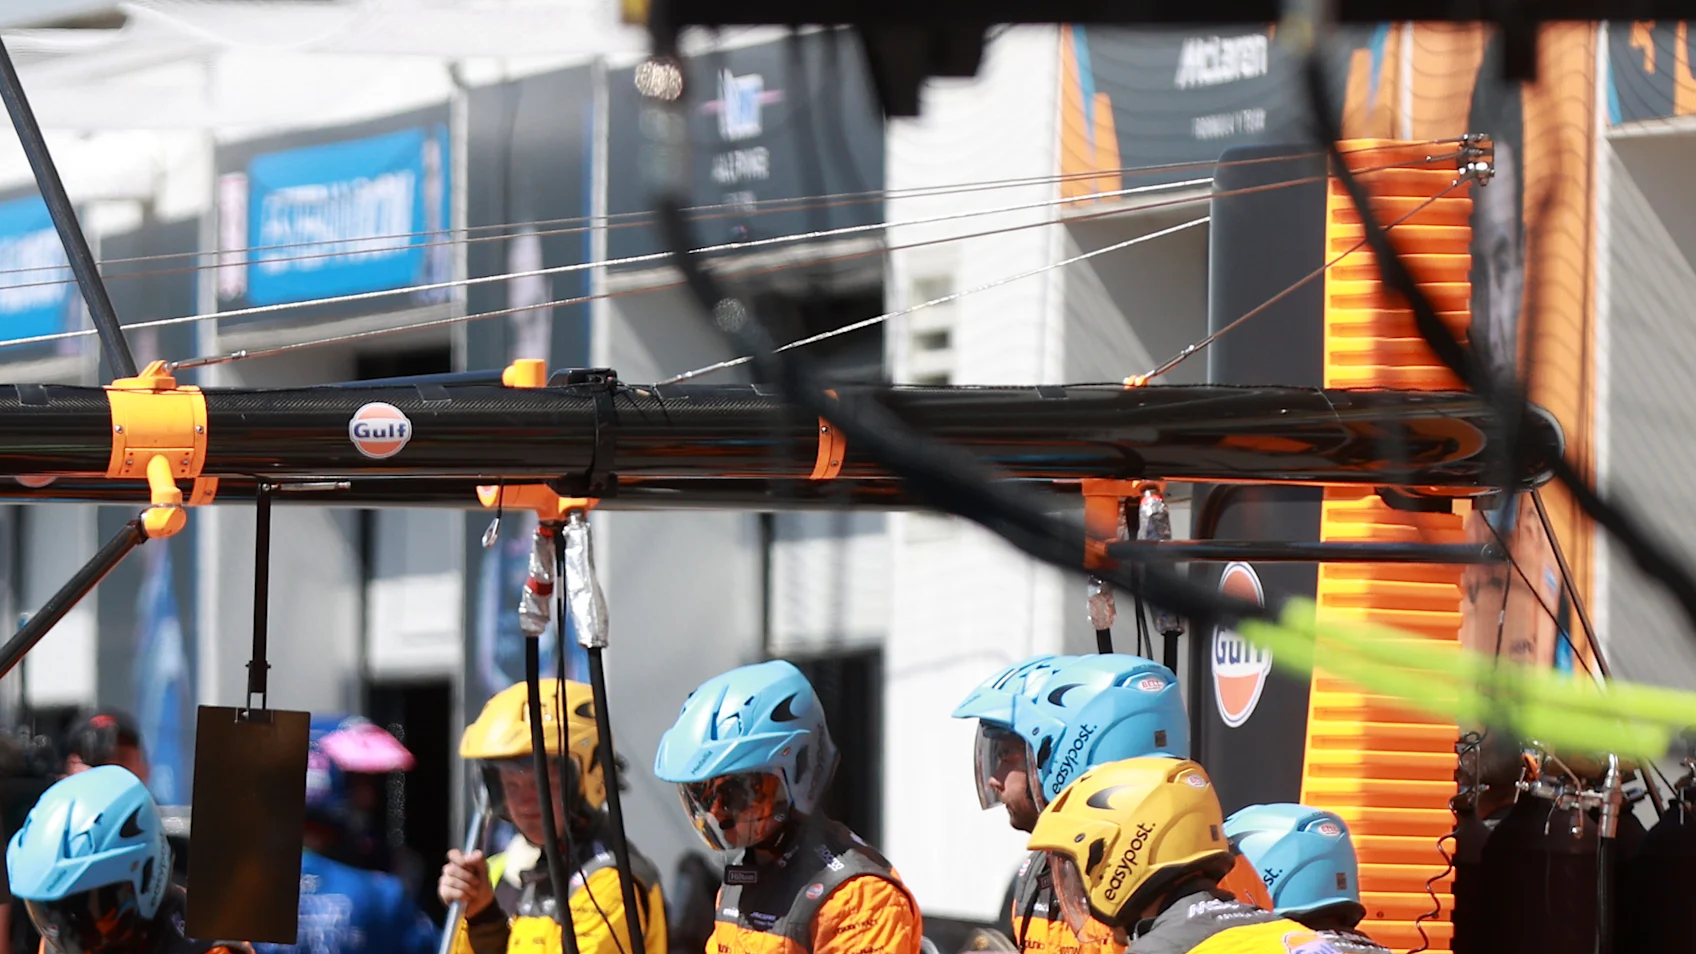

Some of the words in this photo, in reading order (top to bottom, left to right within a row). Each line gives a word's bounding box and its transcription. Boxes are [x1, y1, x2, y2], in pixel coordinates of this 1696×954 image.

[353, 421, 408, 442] Gulf
[1051, 723, 1098, 796] easypost.
[1103, 821, 1158, 902] easypost.
